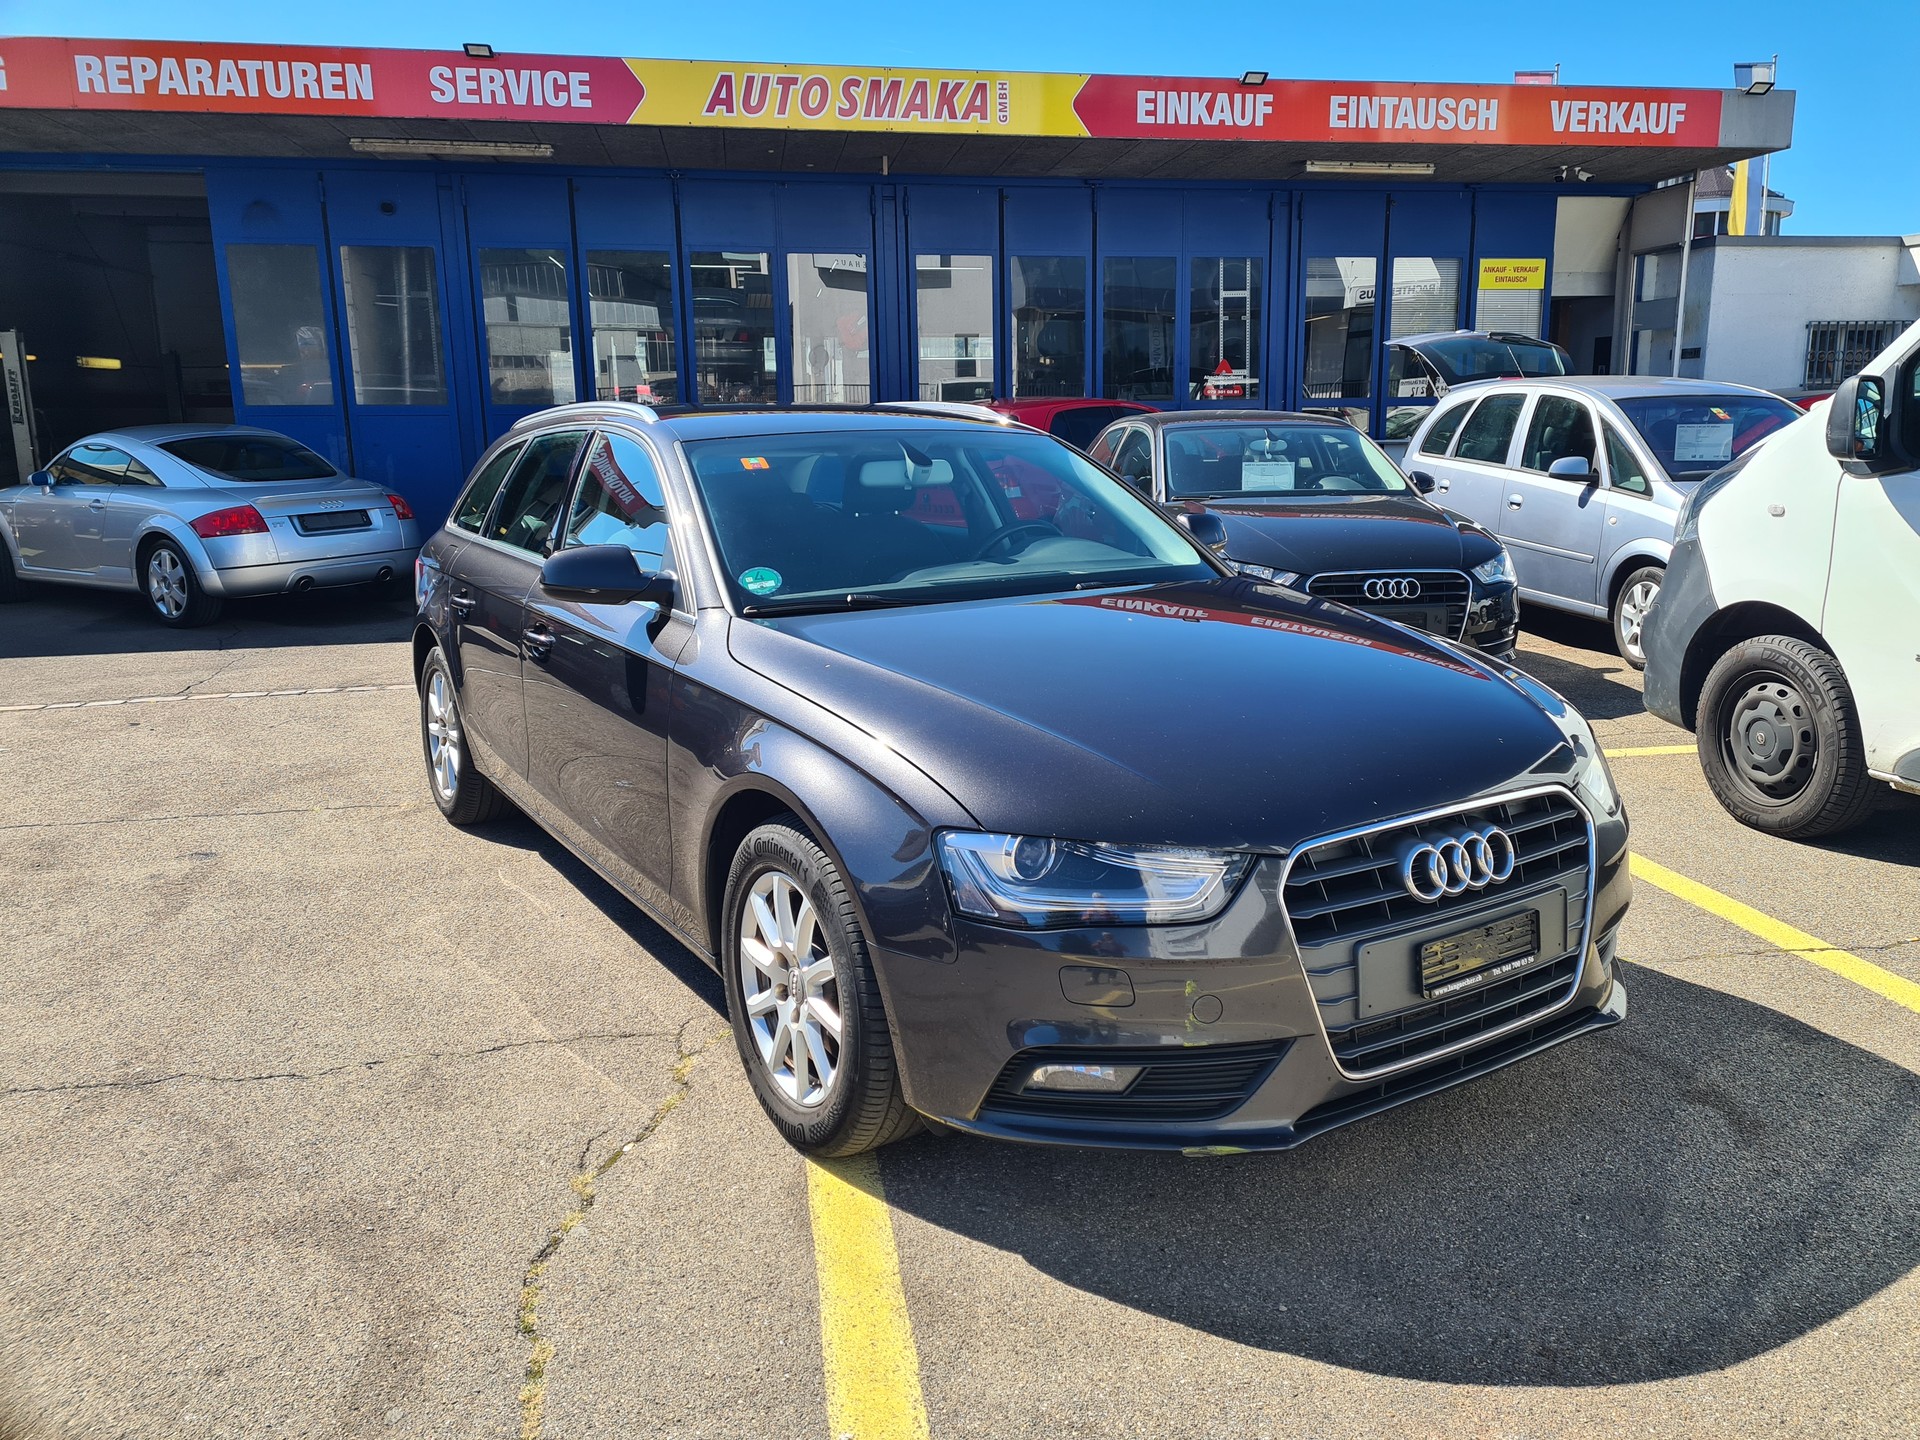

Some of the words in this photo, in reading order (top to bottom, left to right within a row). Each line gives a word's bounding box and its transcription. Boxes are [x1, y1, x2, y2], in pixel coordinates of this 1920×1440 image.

[74, 54, 374, 101] REPARATUREN
[429, 65, 593, 108] SERVICE
[702, 71, 830, 119] AUTO
[836, 76, 990, 123] SMAKA
[997, 81, 1009, 125] GMBH
[1136, 90, 1273, 127] EINKAUF
[1329, 95, 1499, 131] EINTAUSCH
[1550, 100, 1687, 134] VERKAUF
[1494, 275, 1528, 283] EINTAUSCH
[1778, 656, 1823, 709] FULDA
[753, 837, 802, 875] Continental
